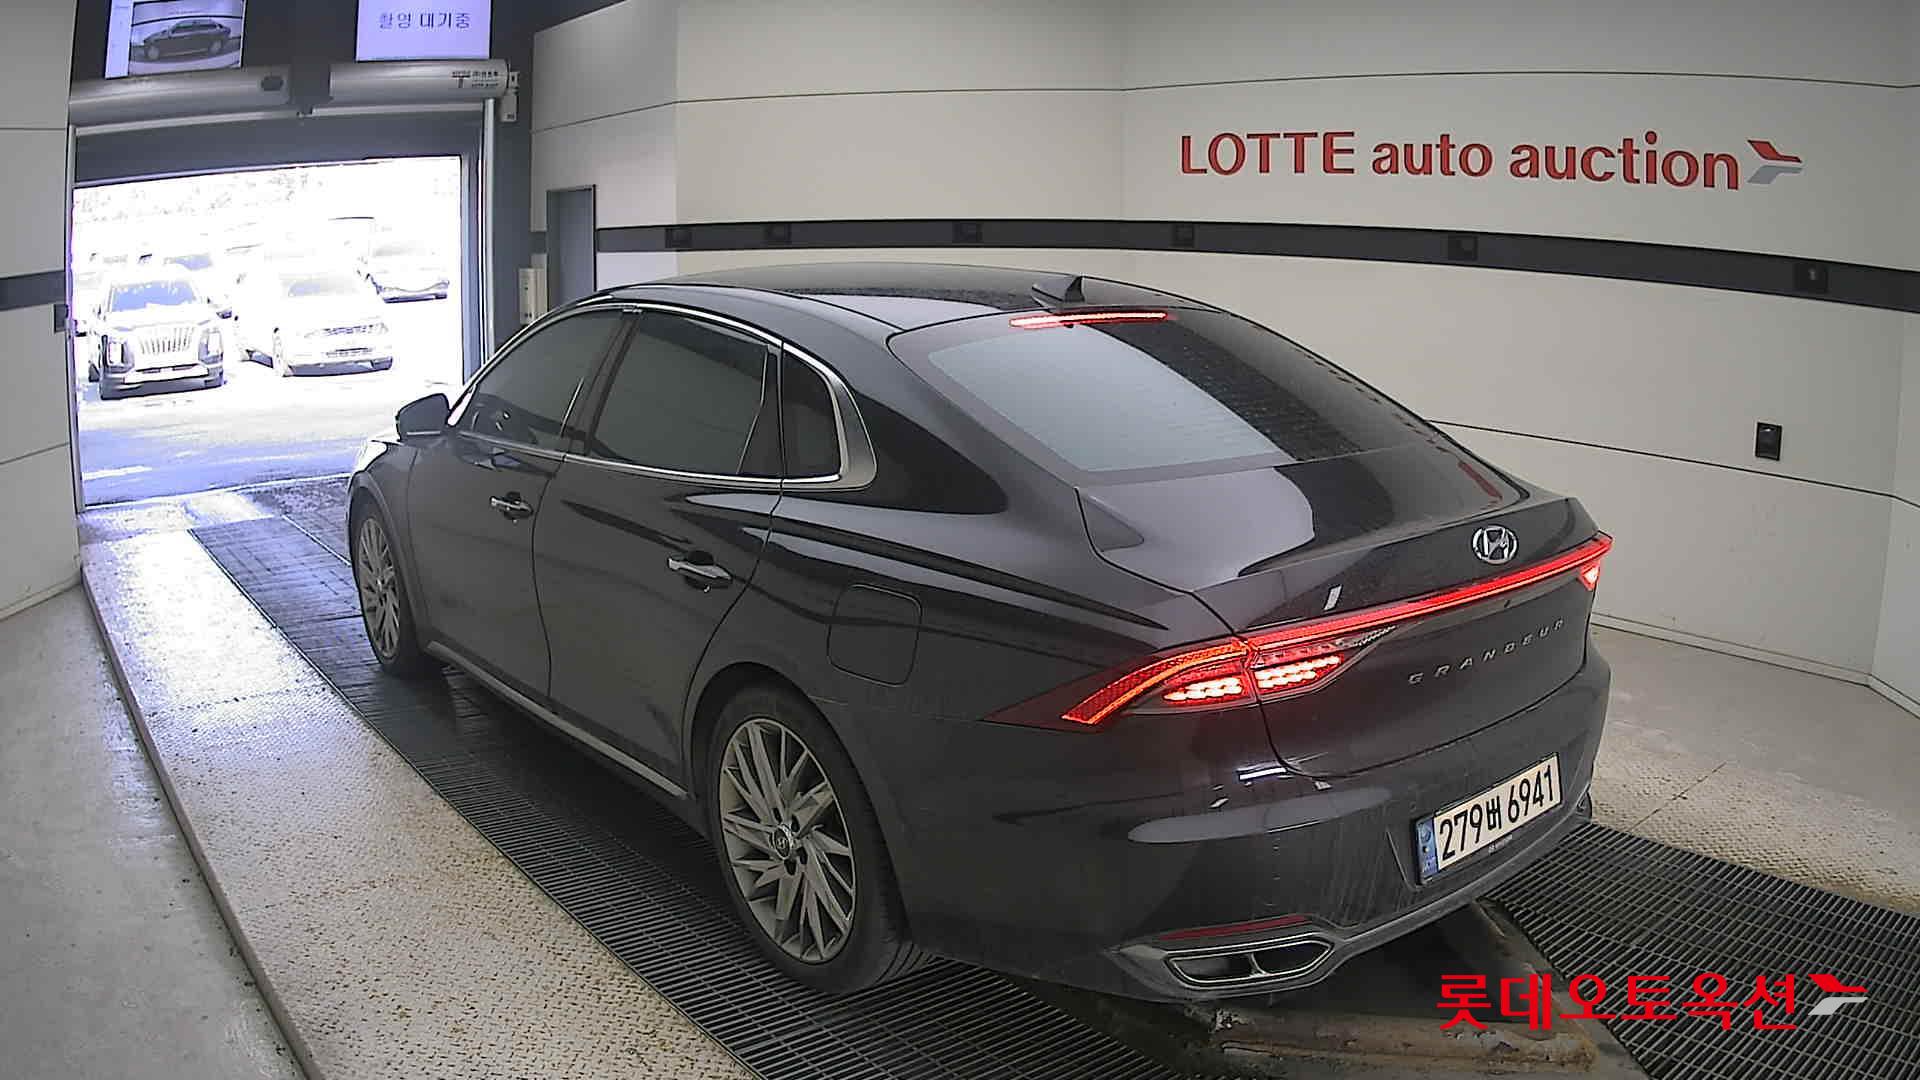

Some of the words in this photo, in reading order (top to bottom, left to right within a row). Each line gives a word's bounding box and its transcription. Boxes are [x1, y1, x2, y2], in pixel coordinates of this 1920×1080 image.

[419, 12, 471, 30] 대기중
[1180, 131, 1356, 176] LOTTE
[1372, 133, 1494, 178] auto
[1509, 130, 1741, 190] auction
[1407, 616, 1566, 686] GRANDEUR
[1438, 795, 1503, 862] 279버
[1507, 764, 1555, 824] 6941
